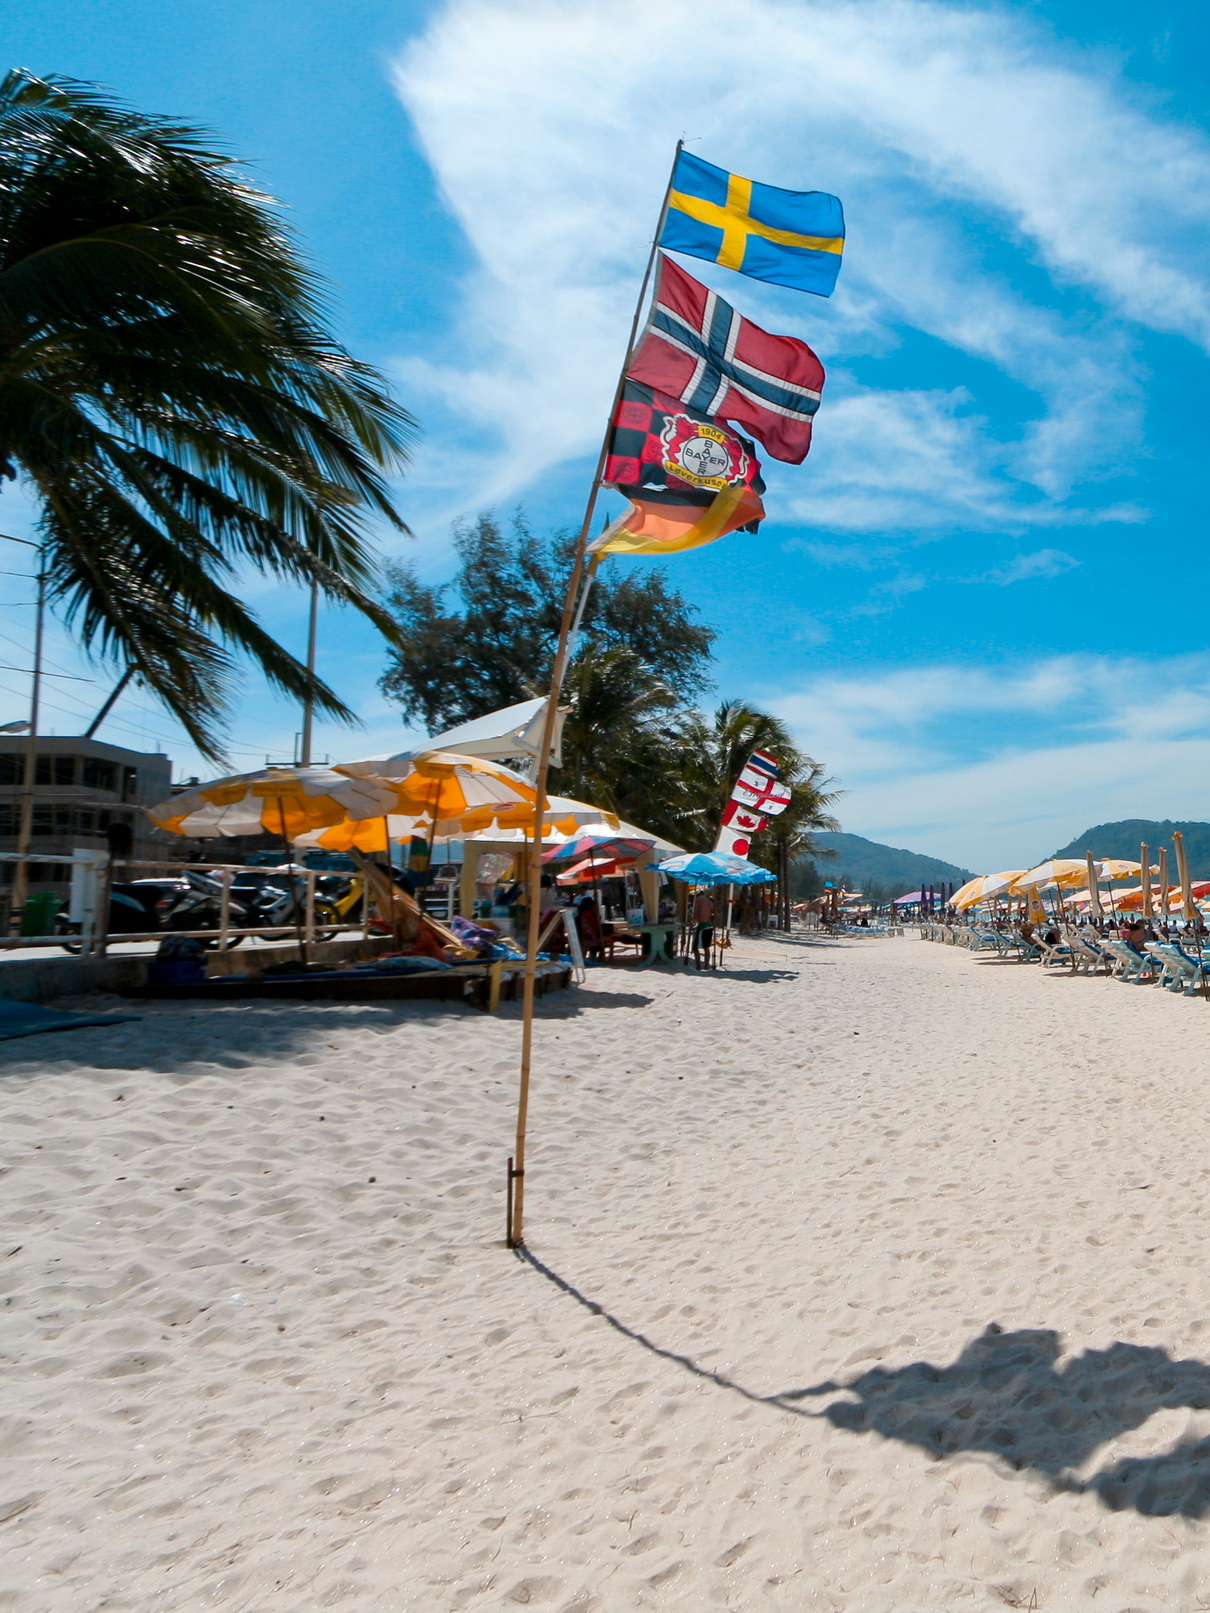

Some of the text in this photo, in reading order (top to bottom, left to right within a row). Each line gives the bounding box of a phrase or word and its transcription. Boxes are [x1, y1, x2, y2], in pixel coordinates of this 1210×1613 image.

[701, 427, 722, 440] 1904
[685, 449, 726, 466] BAYER
[697, 440, 713, 475] BAYER
